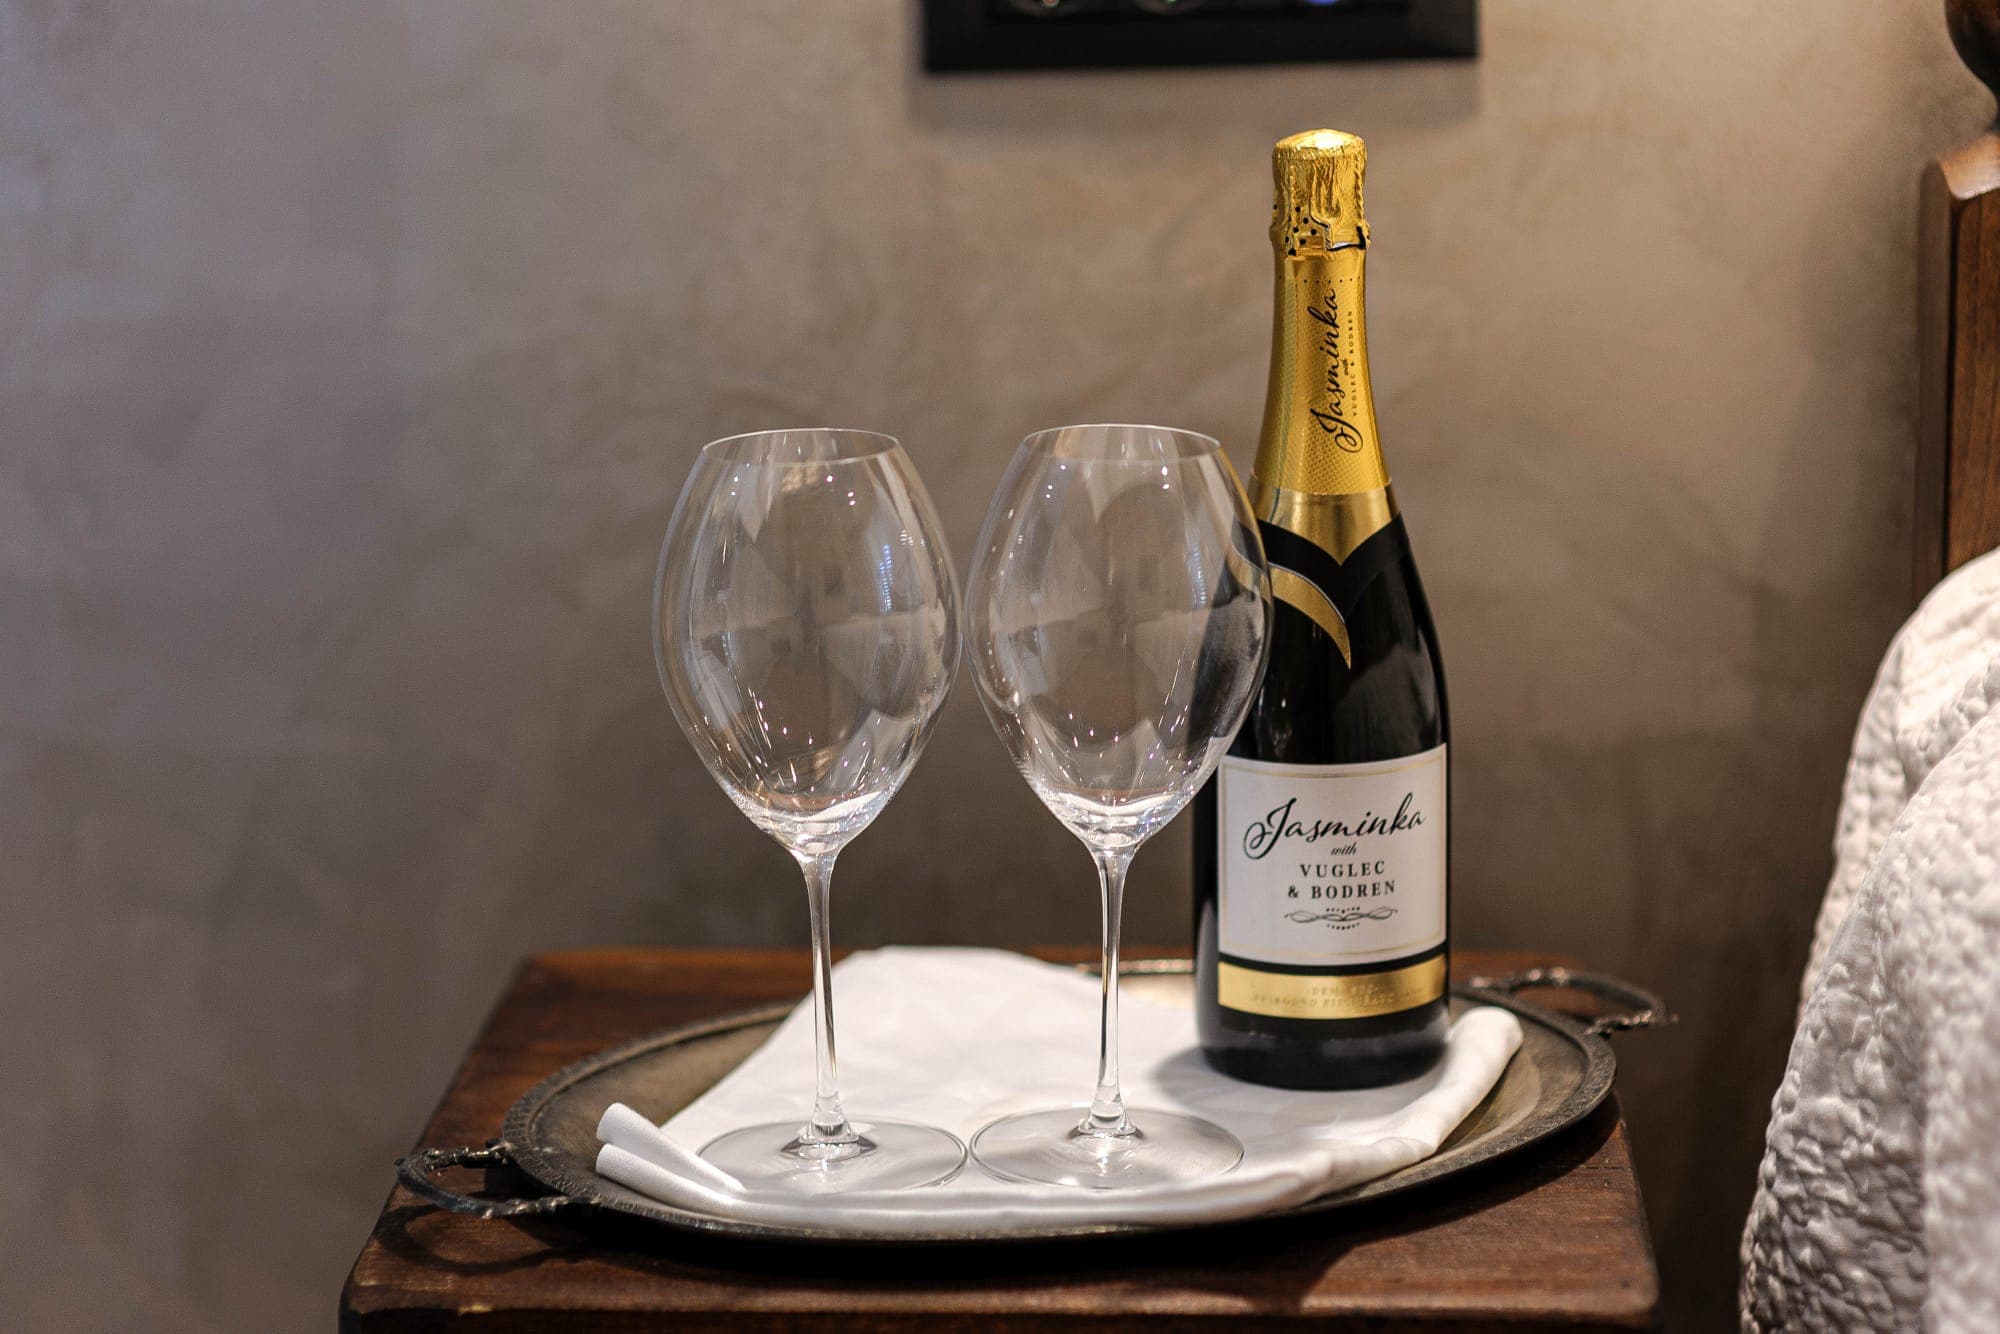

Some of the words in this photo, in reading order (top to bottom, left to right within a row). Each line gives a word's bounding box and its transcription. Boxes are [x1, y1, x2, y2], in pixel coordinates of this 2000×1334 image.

[1307, 288, 1363, 453] Jasminka
[1243, 792, 1426, 859] Jasminka
[1331, 842, 1357, 856] with
[1300, 861, 1385, 878] VUGLEC
[1288, 885, 1299, 899] &
[1311, 880, 1395, 900] BODREN
